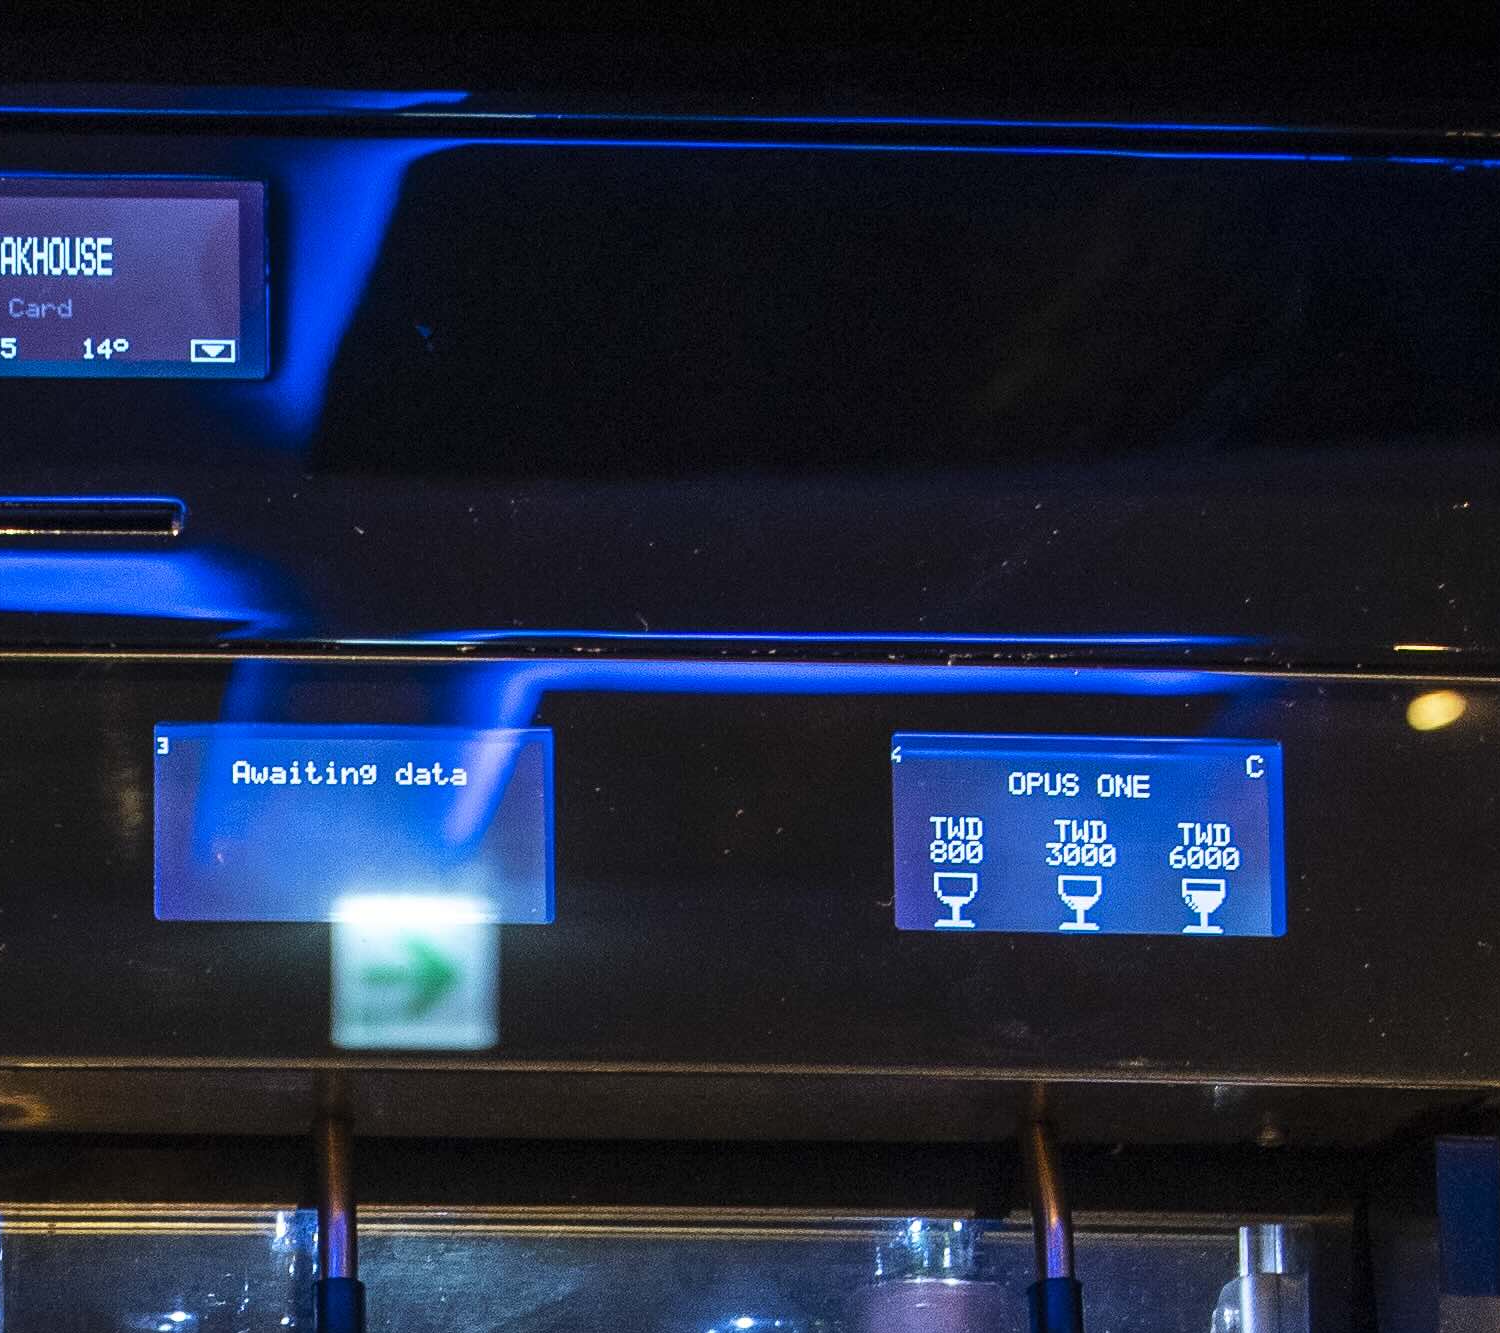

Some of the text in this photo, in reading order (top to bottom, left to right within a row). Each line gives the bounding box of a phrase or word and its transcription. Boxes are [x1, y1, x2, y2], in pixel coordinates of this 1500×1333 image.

[8, 297, 73, 319] Card
[156, 736, 169, 755] 3
[231, 760, 468, 787] Awaiting data
[1245, 754, 1265, 779] C
[1008, 771, 1150, 799] OPUS ONE
[929, 816, 1231, 846] TWD TWD TWD
[929, 840, 1240, 870] 800 3000 6000
